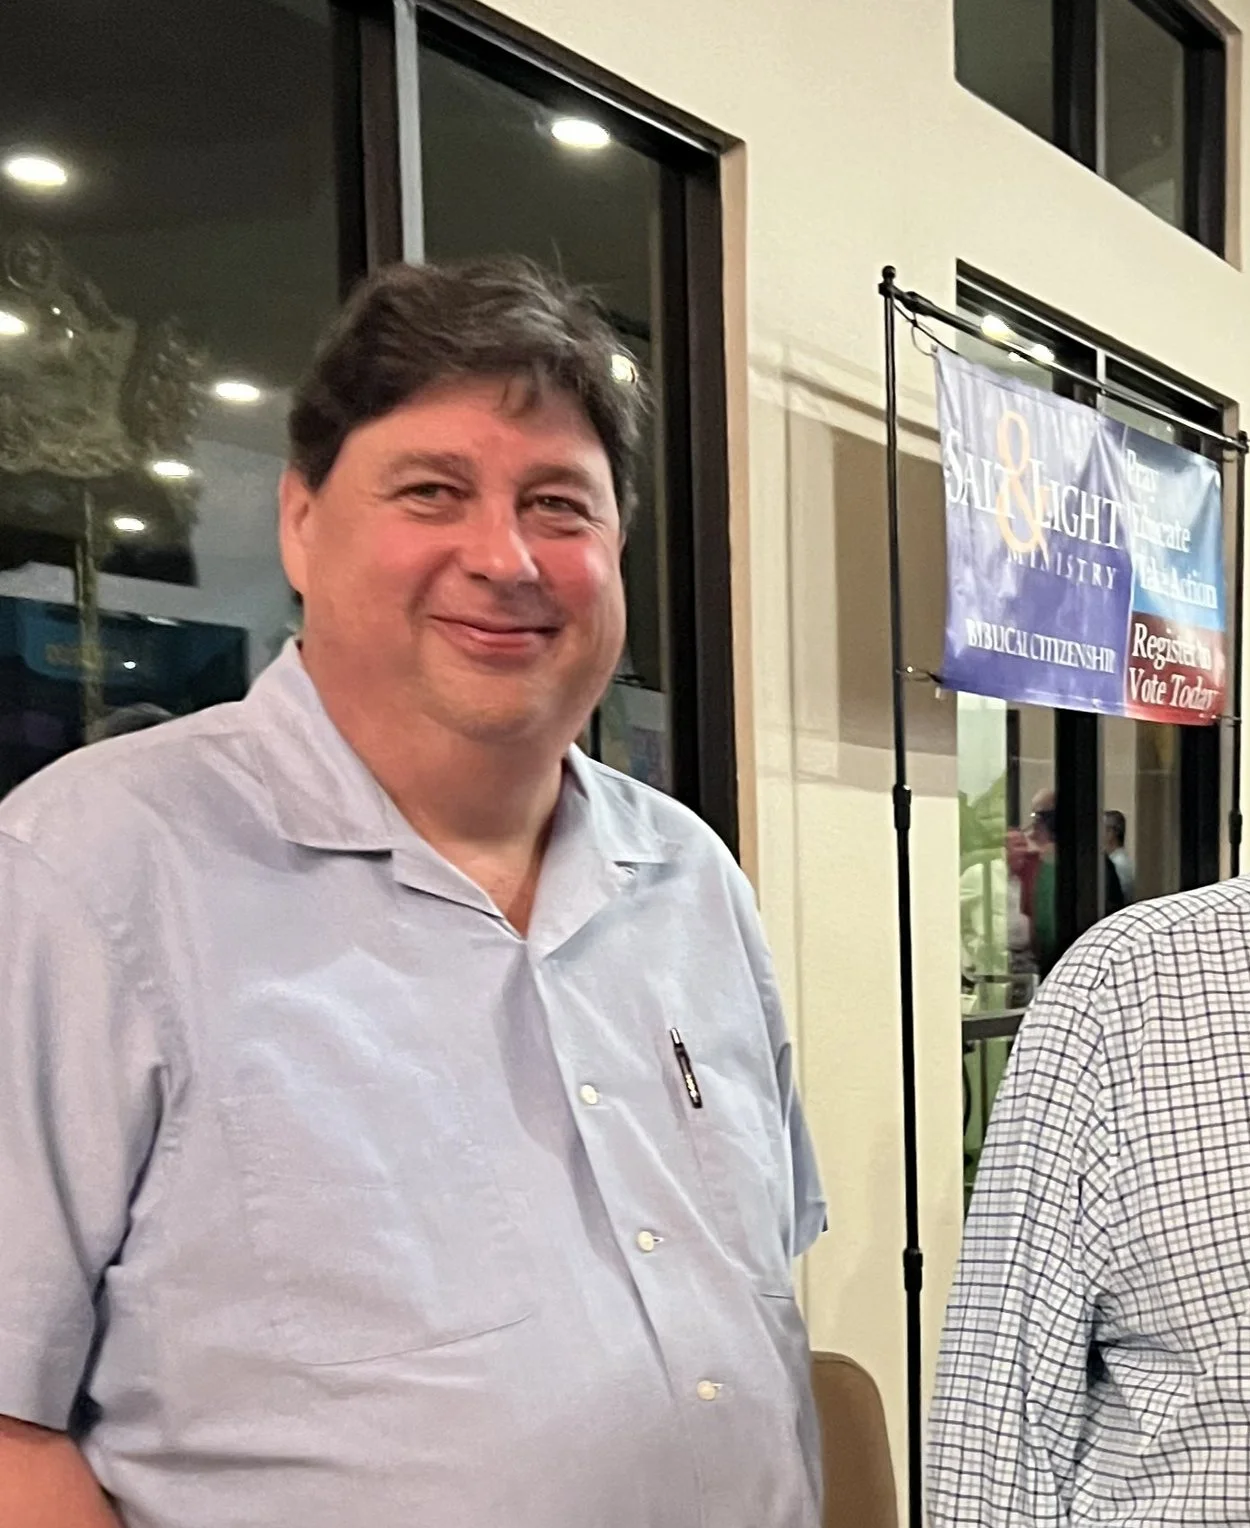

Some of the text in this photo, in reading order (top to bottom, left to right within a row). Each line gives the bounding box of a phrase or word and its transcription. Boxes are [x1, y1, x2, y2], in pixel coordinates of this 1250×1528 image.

[945, 410, 1123, 569] SALT & LIGHT
[1007, 547, 1118, 591] MINISTRY
[965, 618, 1118, 674] BIBLICAL CITIZENSHIP
[1131, 622, 1197, 670] Register
[1128, 667, 1221, 713] Vote Today
